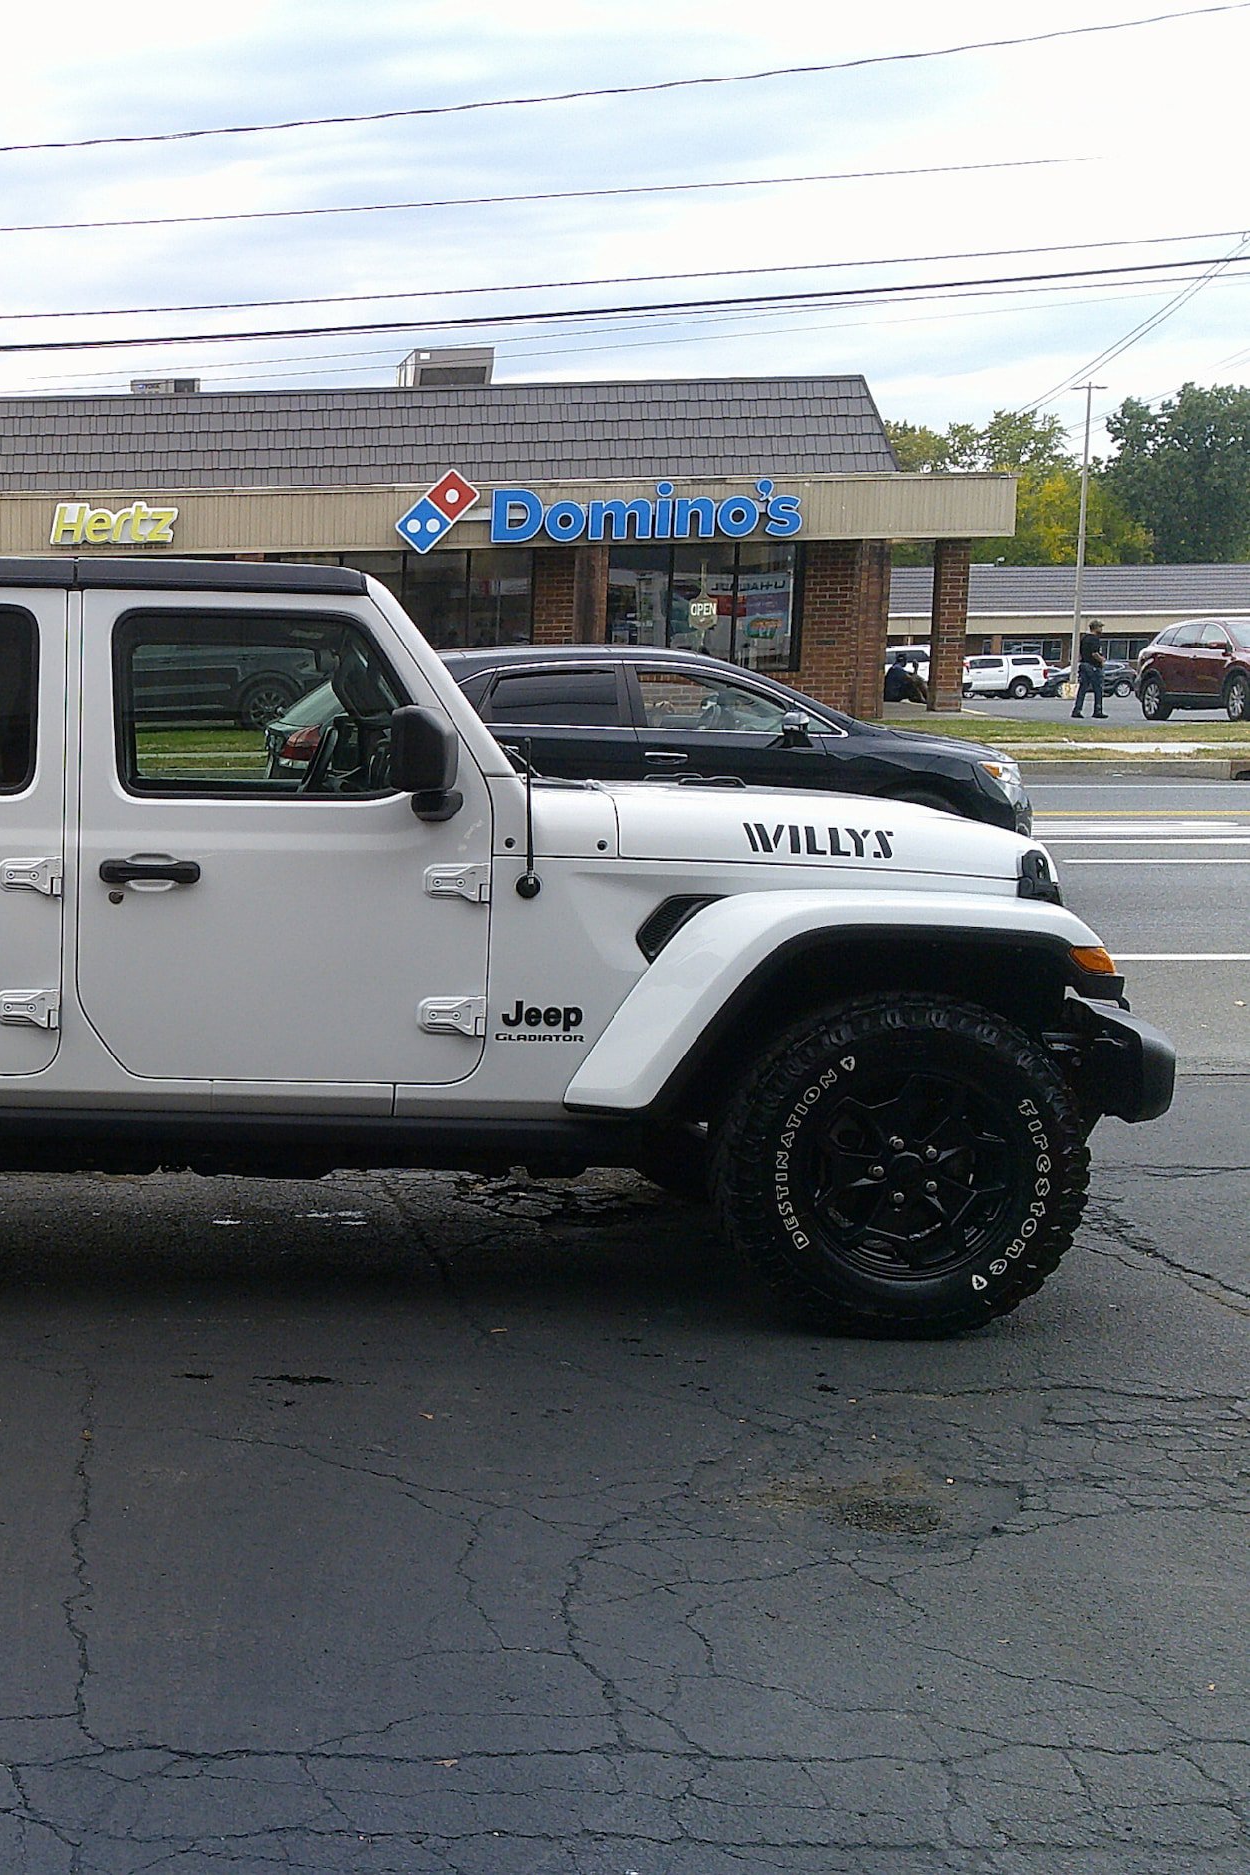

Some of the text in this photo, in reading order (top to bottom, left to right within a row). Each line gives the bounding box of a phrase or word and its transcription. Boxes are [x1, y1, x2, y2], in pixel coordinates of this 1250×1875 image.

[52, 503, 176, 544] Hertz
[491, 479, 803, 543] Domino's
[690, 602, 718, 616] OPEN
[742, 823, 894, 859] WILLYS
[501, 1000, 583, 1032] Jeep
[495, 1033, 585, 1042] GLADIATOR
[775, 1069, 838, 1250] DESTINATION
